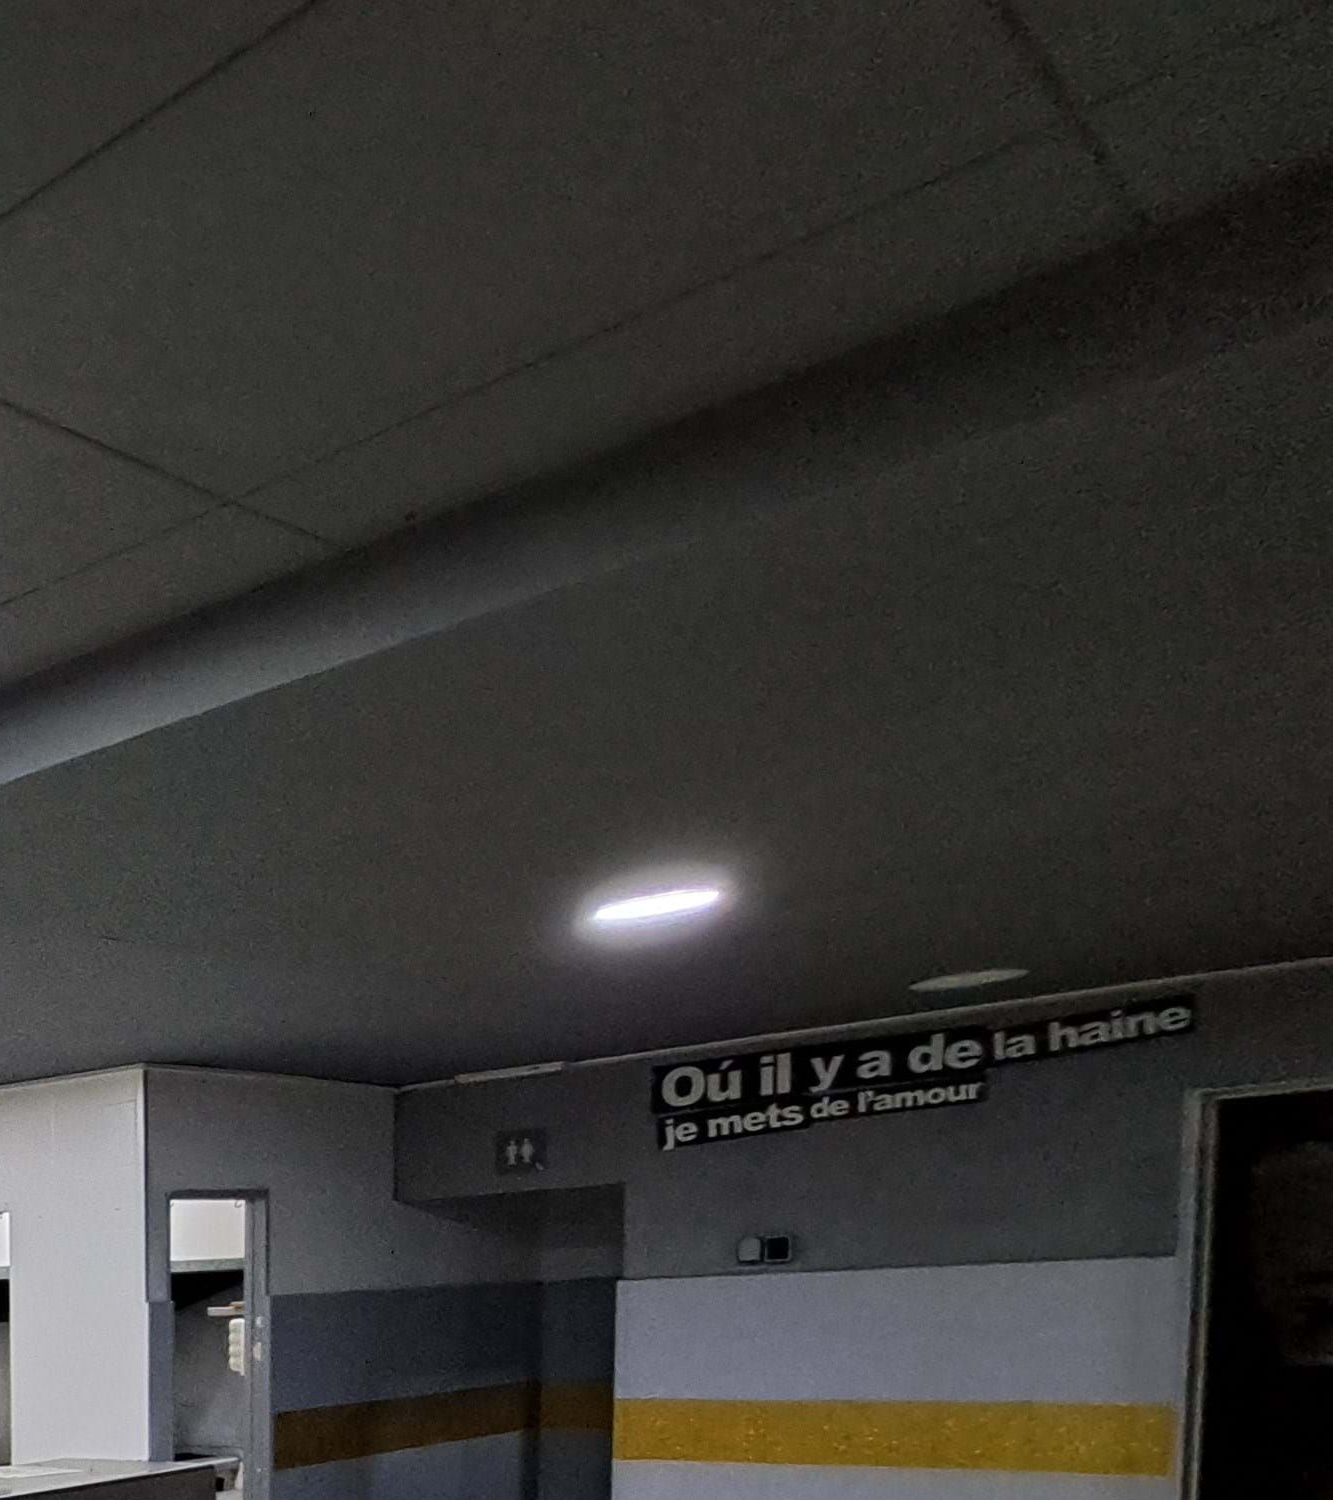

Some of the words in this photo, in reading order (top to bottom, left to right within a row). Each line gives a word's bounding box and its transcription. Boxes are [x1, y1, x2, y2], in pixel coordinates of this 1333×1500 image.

[760, 1052, 791, 1096] il
[809, 1054, 845, 1093] y
[856, 1050, 892, 1079] a
[907, 1033, 983, 1074] de
[993, 1031, 1036, 1060] la
[1048, 1006, 1192, 1051] haine
[662, 1118, 699, 1151] je
[707, 1102, 805, 1138] mets
[810, 1096, 850, 1118] de
[857, 1082, 984, 1113] l'amour
